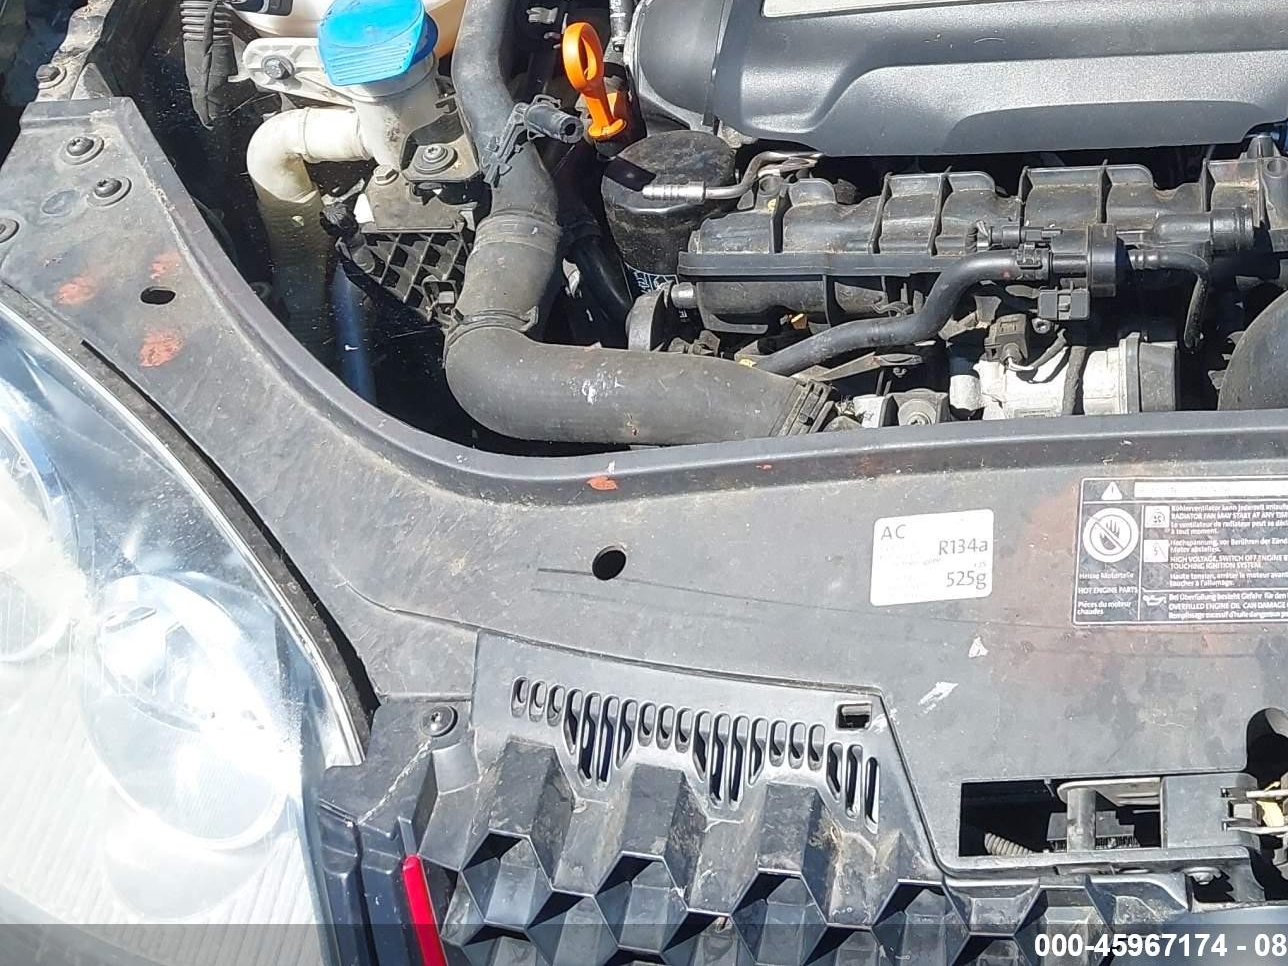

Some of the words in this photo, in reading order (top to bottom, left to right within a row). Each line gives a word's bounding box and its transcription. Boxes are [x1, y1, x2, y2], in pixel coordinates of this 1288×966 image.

[1217, 512, 1232, 520] MAY
[880, 524, 906, 541] AC
[938, 537, 988, 556] R134a
[946, 570, 987, 590] 525g
[1118, 586, 1138, 594] PARTS
